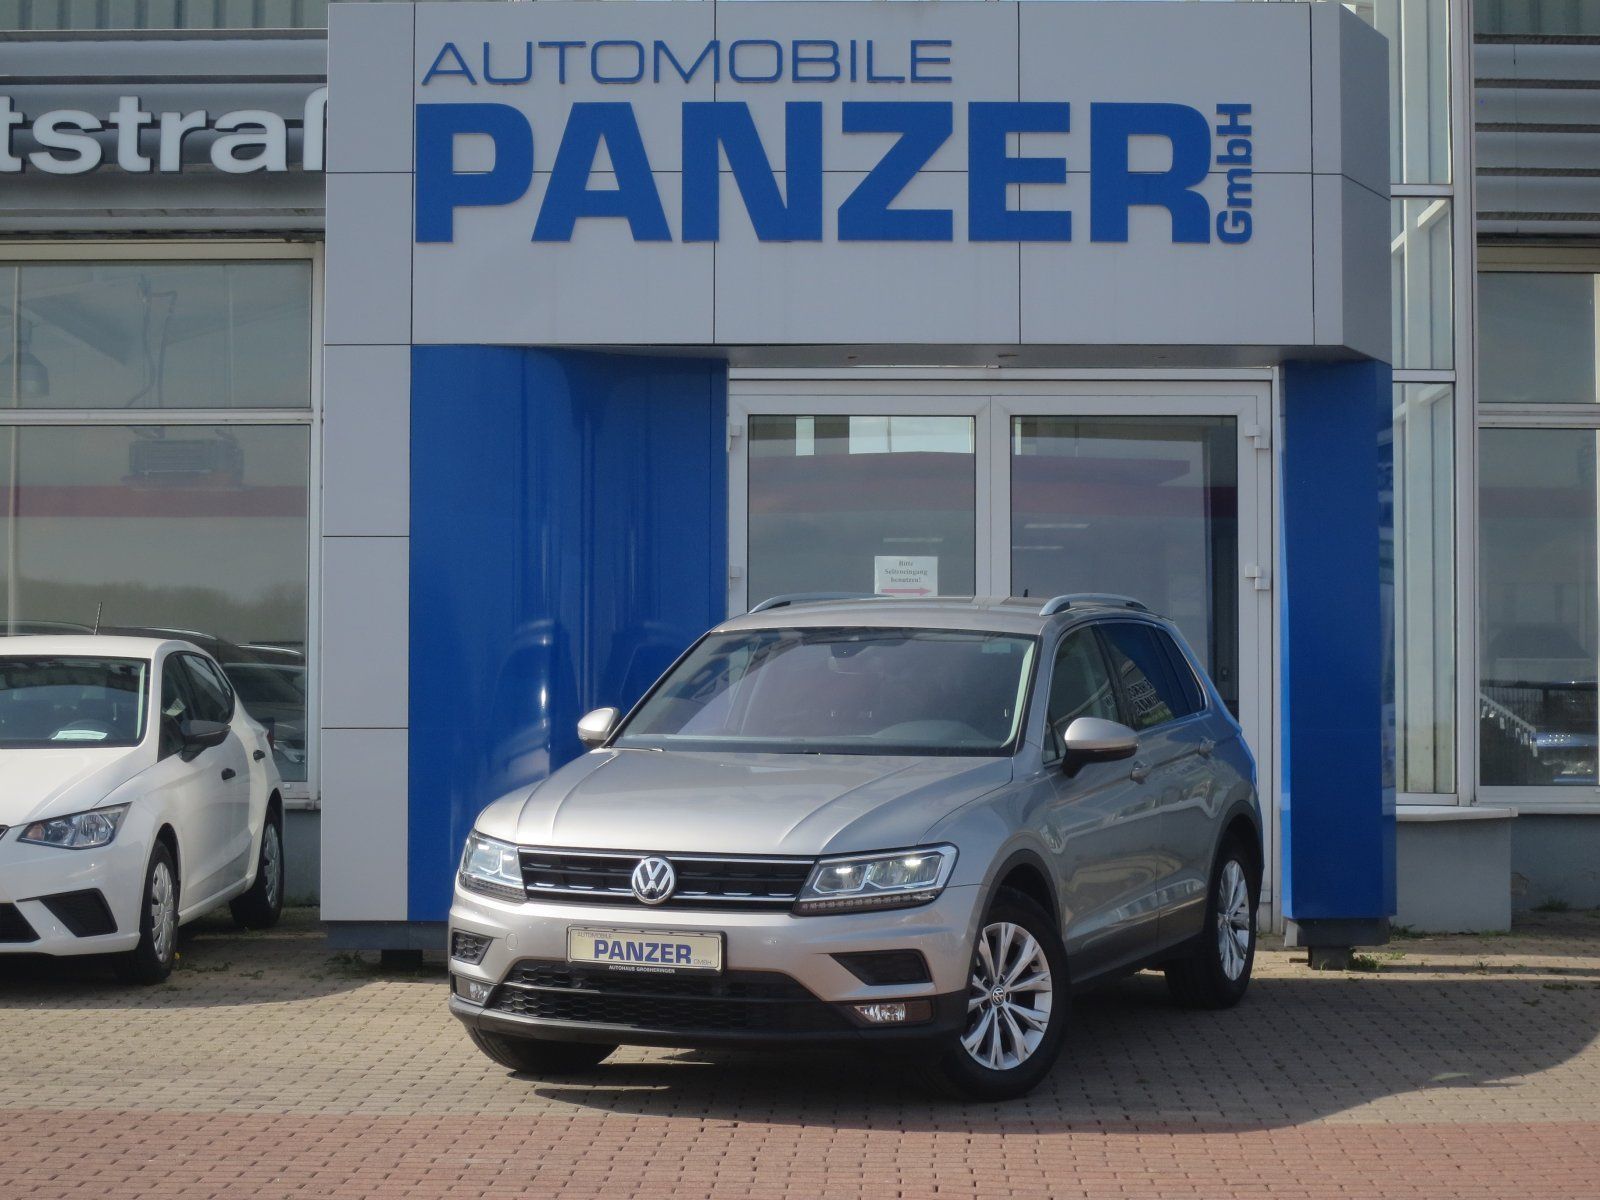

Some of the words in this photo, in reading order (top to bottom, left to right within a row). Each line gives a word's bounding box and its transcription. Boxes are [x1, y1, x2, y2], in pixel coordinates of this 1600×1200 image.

[421, 39, 952, 84] AUTOMOBILE
[414, 101, 1210, 243] PANZER
[1216, 103, 1254, 244] GmbH
[594, 939, 692, 964] PANZER
